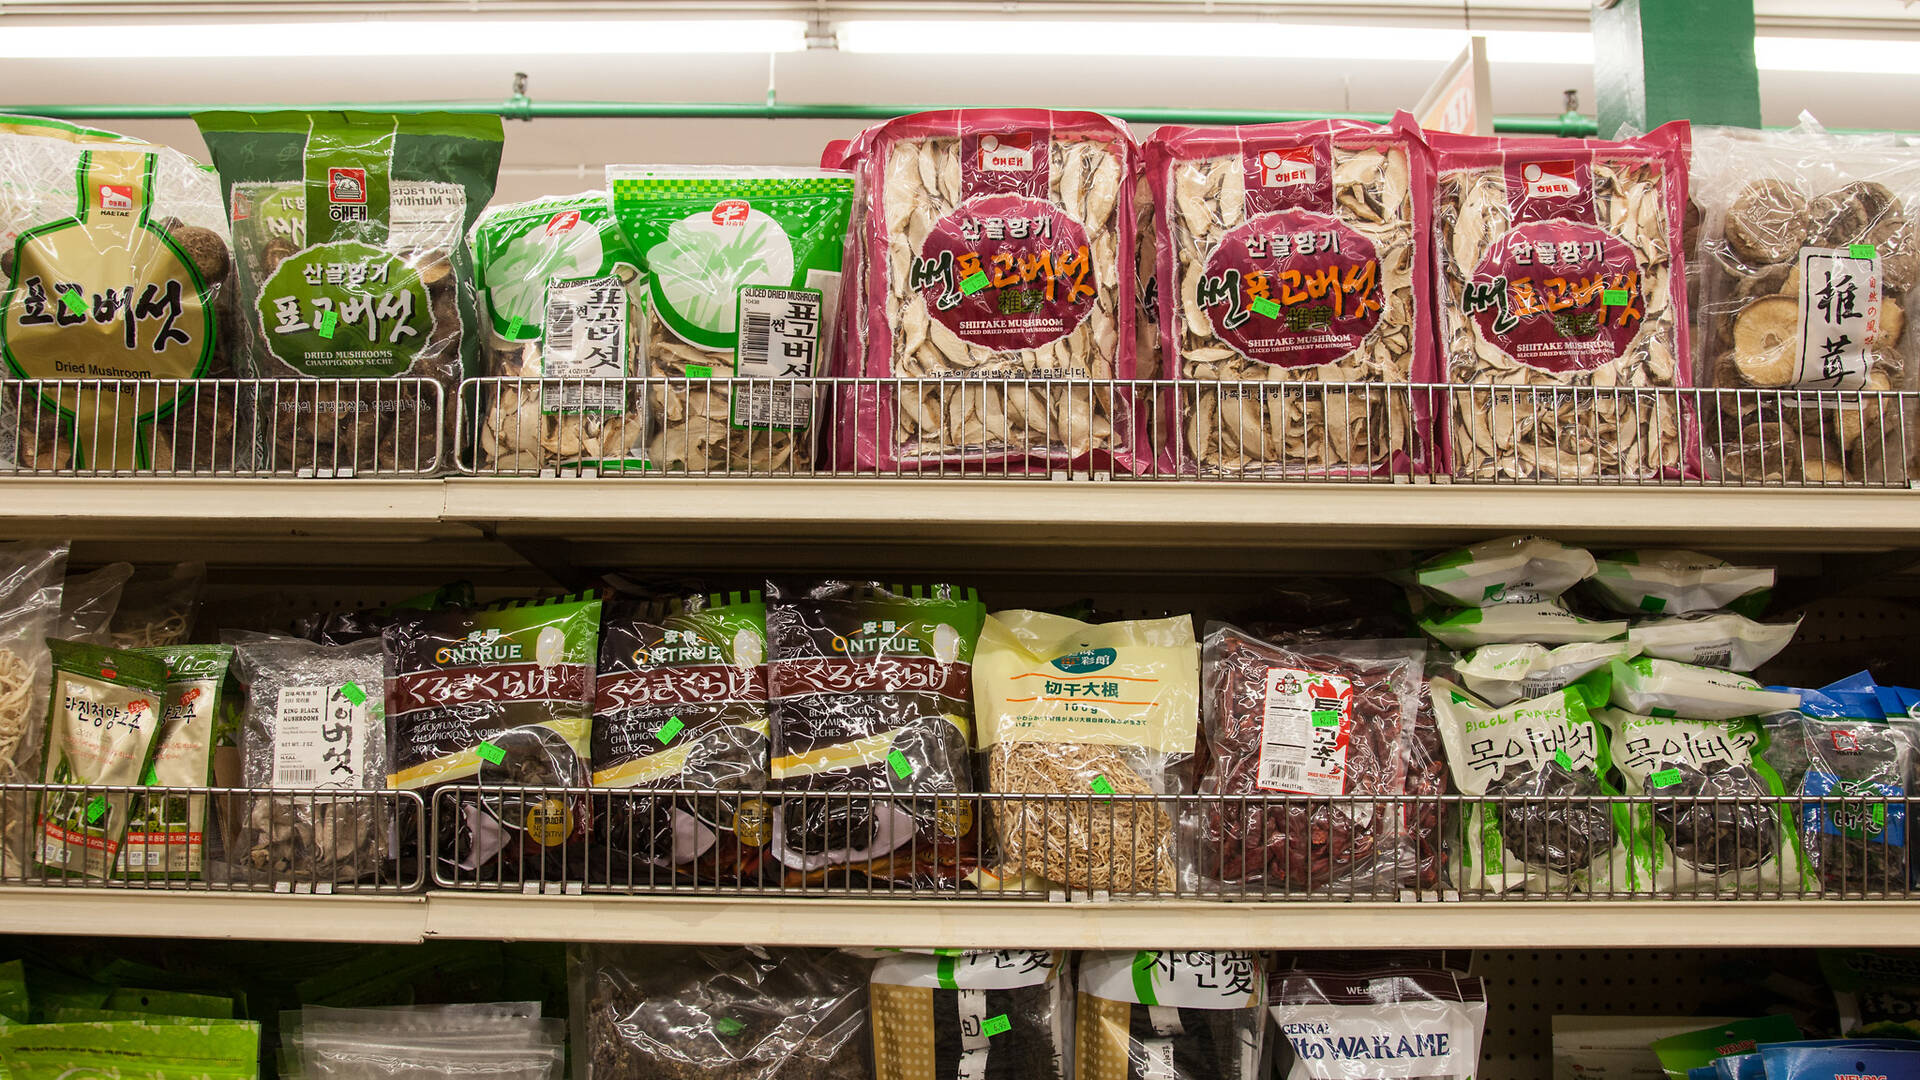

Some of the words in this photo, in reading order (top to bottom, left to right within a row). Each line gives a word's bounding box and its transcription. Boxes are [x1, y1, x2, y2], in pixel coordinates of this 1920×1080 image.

[992, 156, 1024, 168] 해태
[1275, 170, 1307, 183] 해태
[1537, 184, 1569, 192] 해태
[329, 204, 367, 222] 해태
[959, 216, 1053, 241] 산골향기
[1245, 231, 1341, 258] 산골향기
[1511, 241, 1605, 265] 산골향기
[303, 263, 390, 286] 산골향기
[744, 288, 767, 298] SLICED
[767, 289, 787, 299] DRIED
[787, 291, 821, 303] MUSHROOM
[272, 288, 418, 343] 표고버섯
[959, 319, 1007, 330] SHIITAKE
[1008, 318, 1064, 329] MUSHROOM
[584, 287, 624, 369] 표고버섯
[771, 318, 786, 333] 썬
[1247, 337, 1296, 348] SHIITAKE
[1295, 333, 1351, 344] MUSHROOM
[1517, 341, 1564, 352] SHIITAKE
[304, 351, 333, 359] DRIED
[335, 350, 393, 360] MUSHROOMS
[305, 358, 364, 367] CHAMPIGNONS
[55, 360, 86, 374] Dried
[88, 364, 152, 379] Mushroom
[831, 636, 920, 653] ONTRUE
[435, 644, 523, 664] ONTRUE
[633, 646, 722, 665] ONTRUE
[1045, 681, 1119, 698] 切干大根
[1064, 704, 1099, 715] 100g
[611, 722, 635, 734] BLACK
[1465, 714, 1508, 733] Black
[1514, 708, 1561, 723] Fungus
[809, 729, 841, 738] SECHES
[1467, 725, 1596, 775] 목이버섯
[1324, 1033, 1451, 1060] WAKAME
